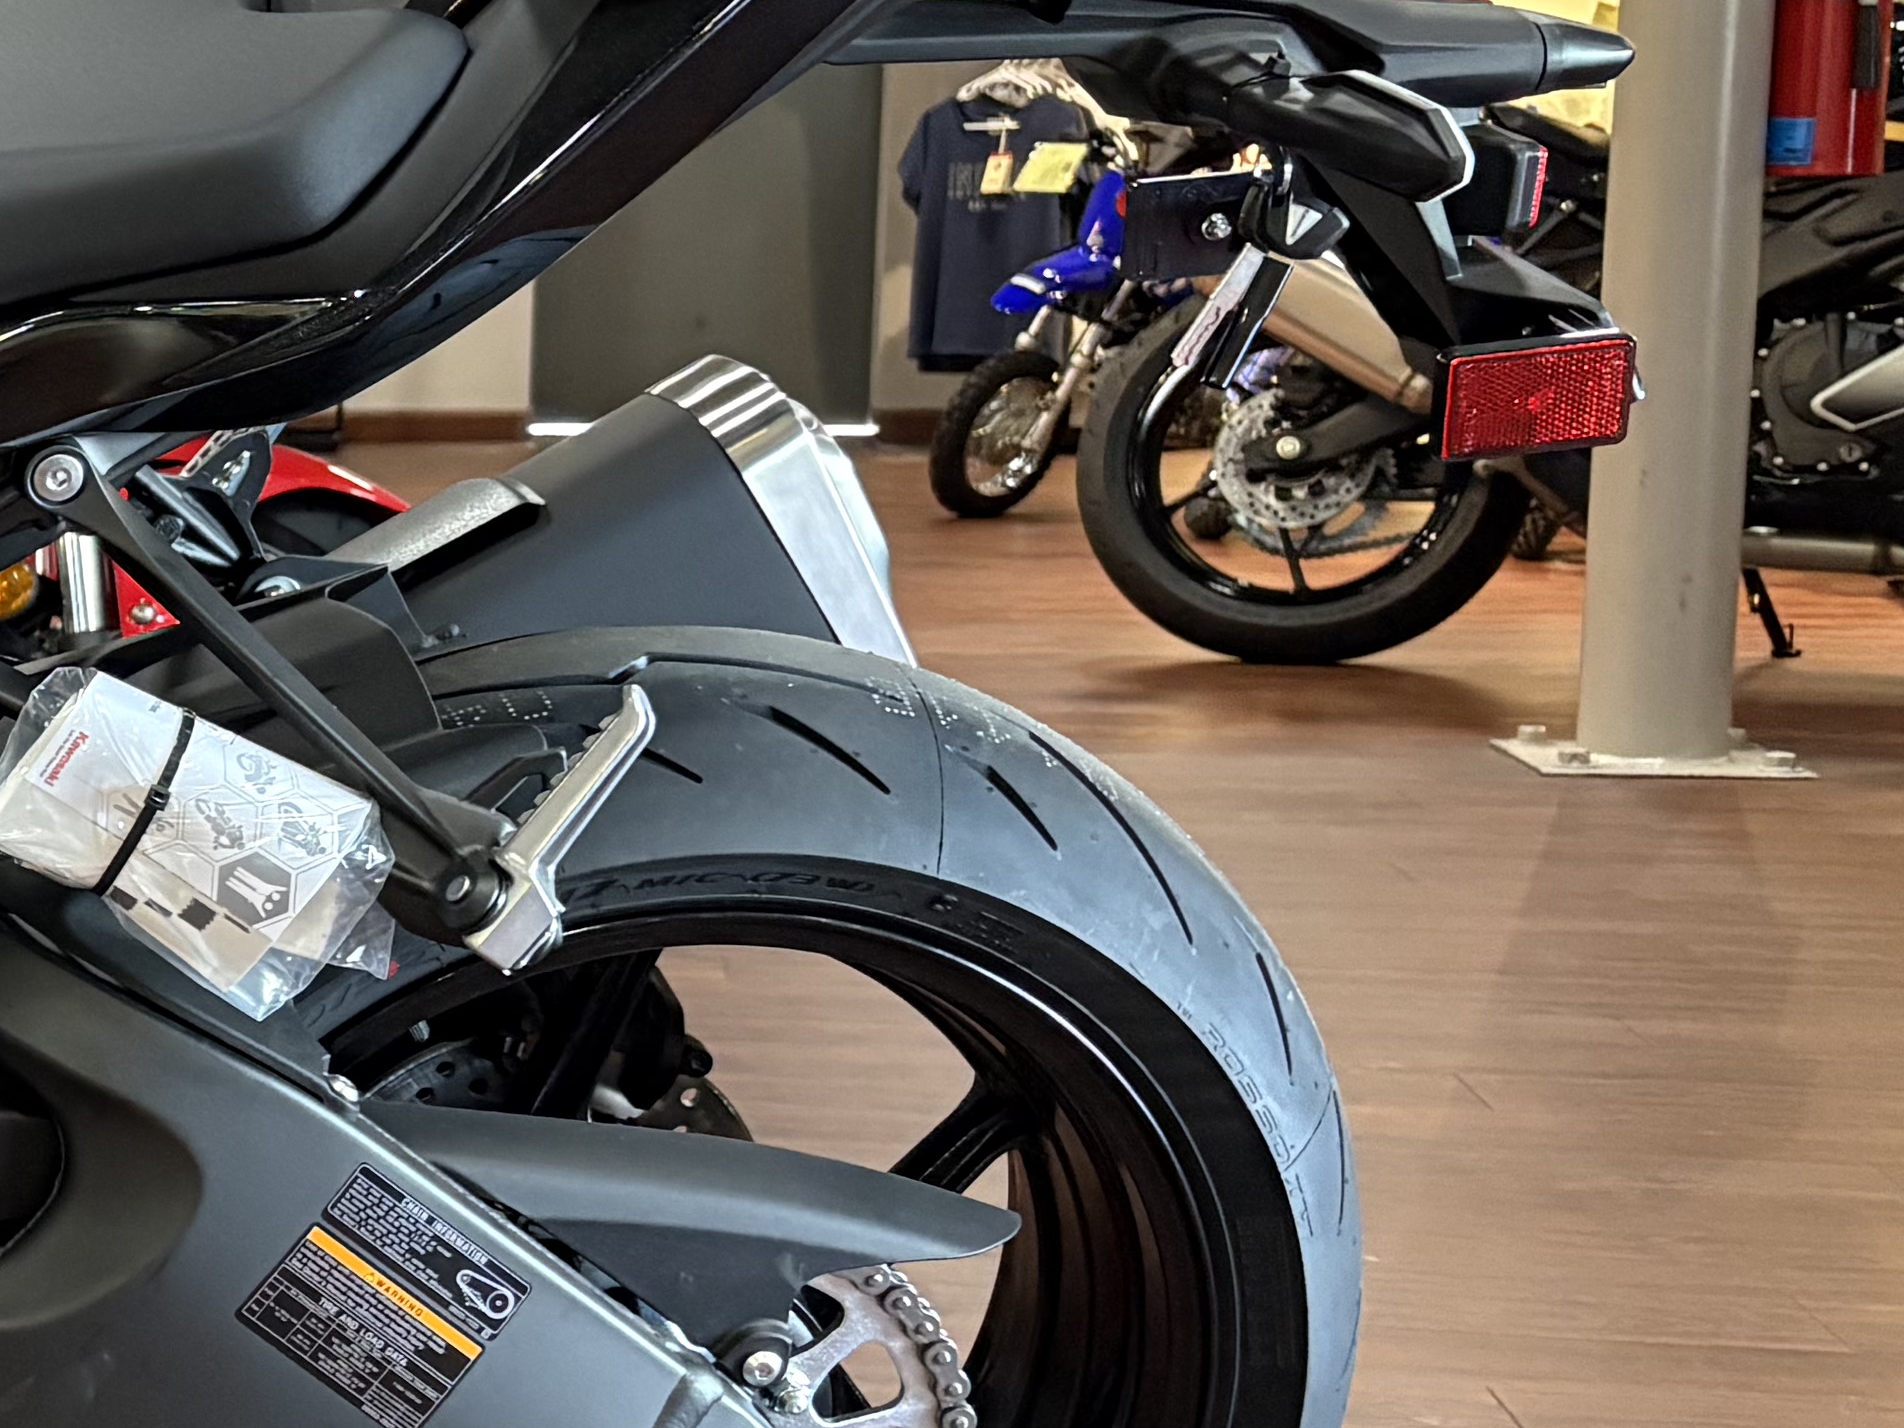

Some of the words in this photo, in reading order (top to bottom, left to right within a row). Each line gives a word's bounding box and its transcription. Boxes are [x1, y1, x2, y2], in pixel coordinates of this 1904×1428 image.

[44, 731, 90, 787] Kawasaki
[401, 1197, 429, 1222] CHAIN
[432, 1218, 489, 1266] INFORMATION
[374, 1278, 424, 1318] WARNING
[339, 1311, 359, 1330] AND
[359, 1327, 385, 1349] LOAD
